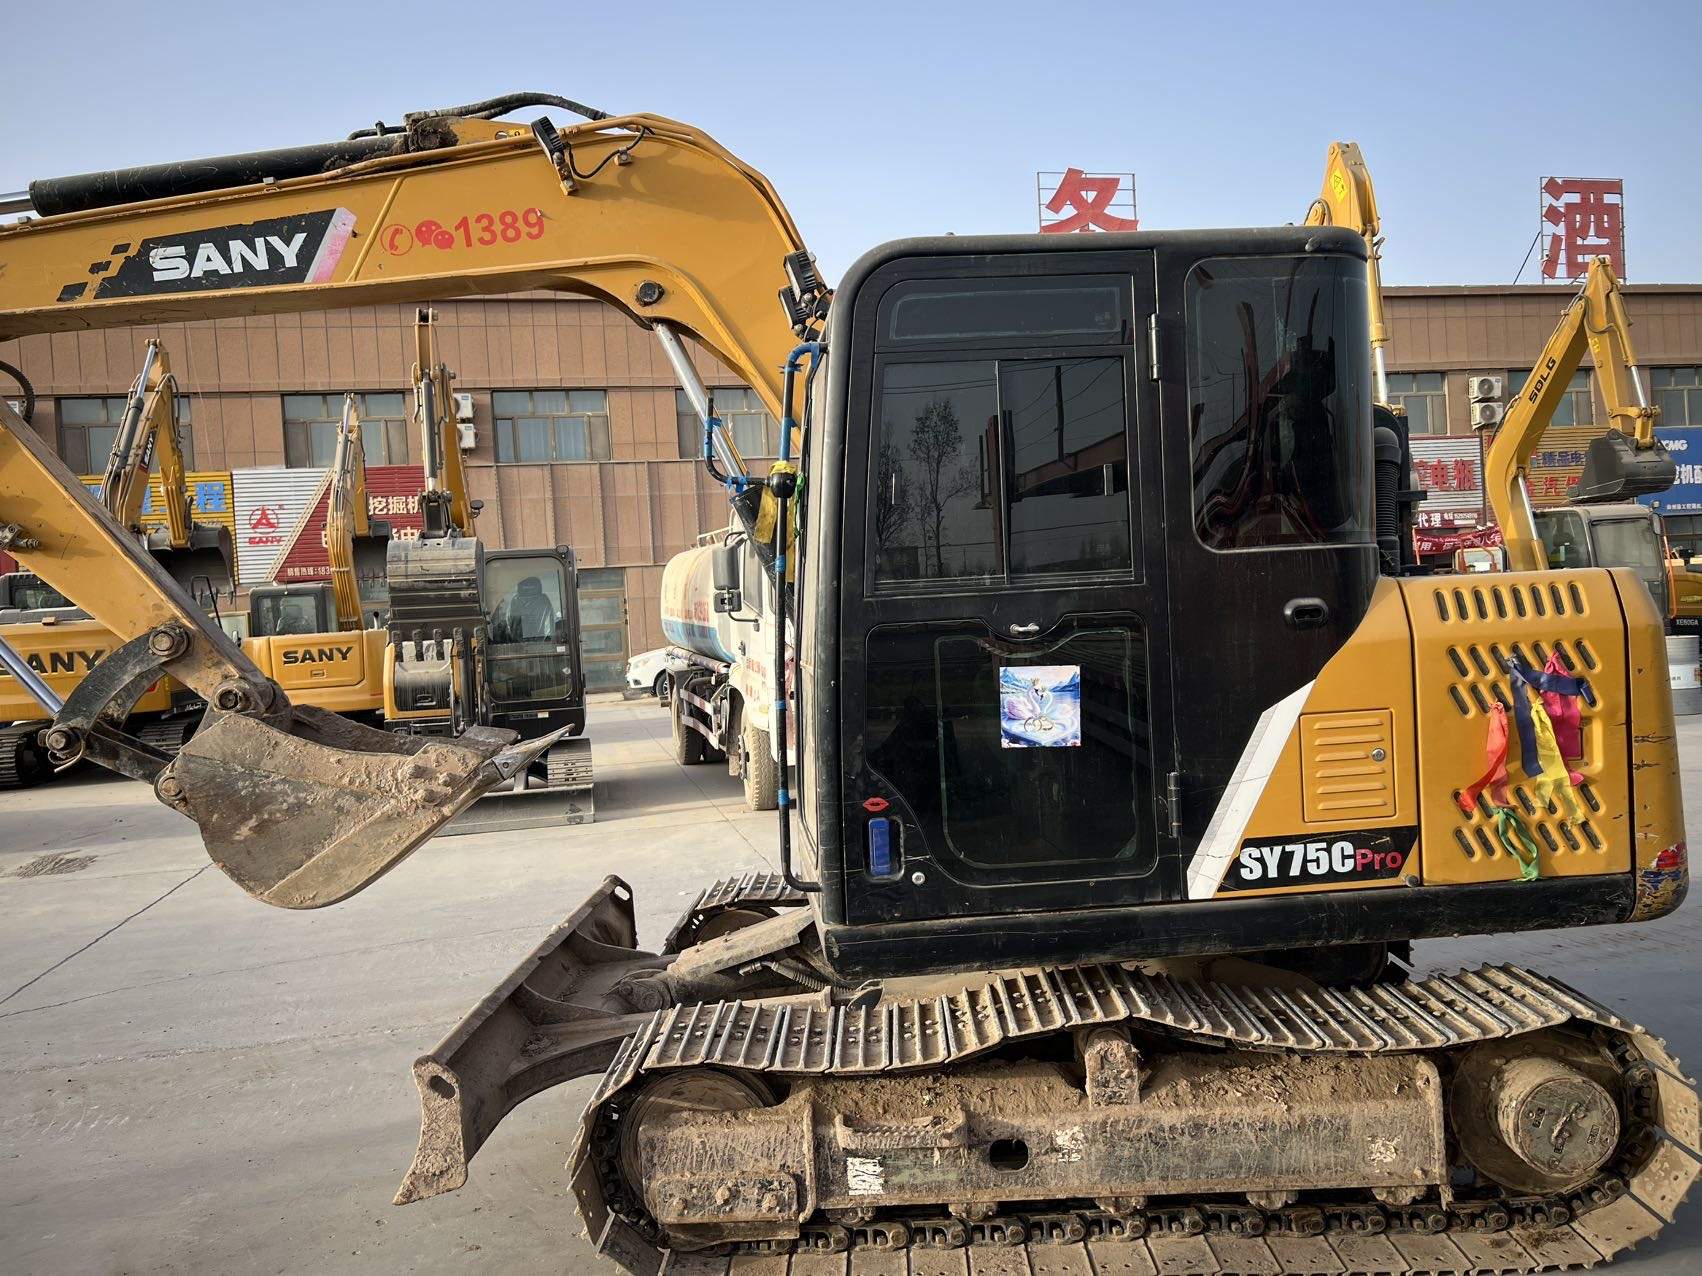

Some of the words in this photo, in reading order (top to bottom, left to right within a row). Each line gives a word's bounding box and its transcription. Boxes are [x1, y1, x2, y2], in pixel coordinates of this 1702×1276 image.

[454, 207, 545, 248] 1389
[1542, 176, 1625, 279] 酒
[149, 232, 308, 282] SANY
[0, 649, 106, 676] ANY
[282, 646, 354, 666] SANY
